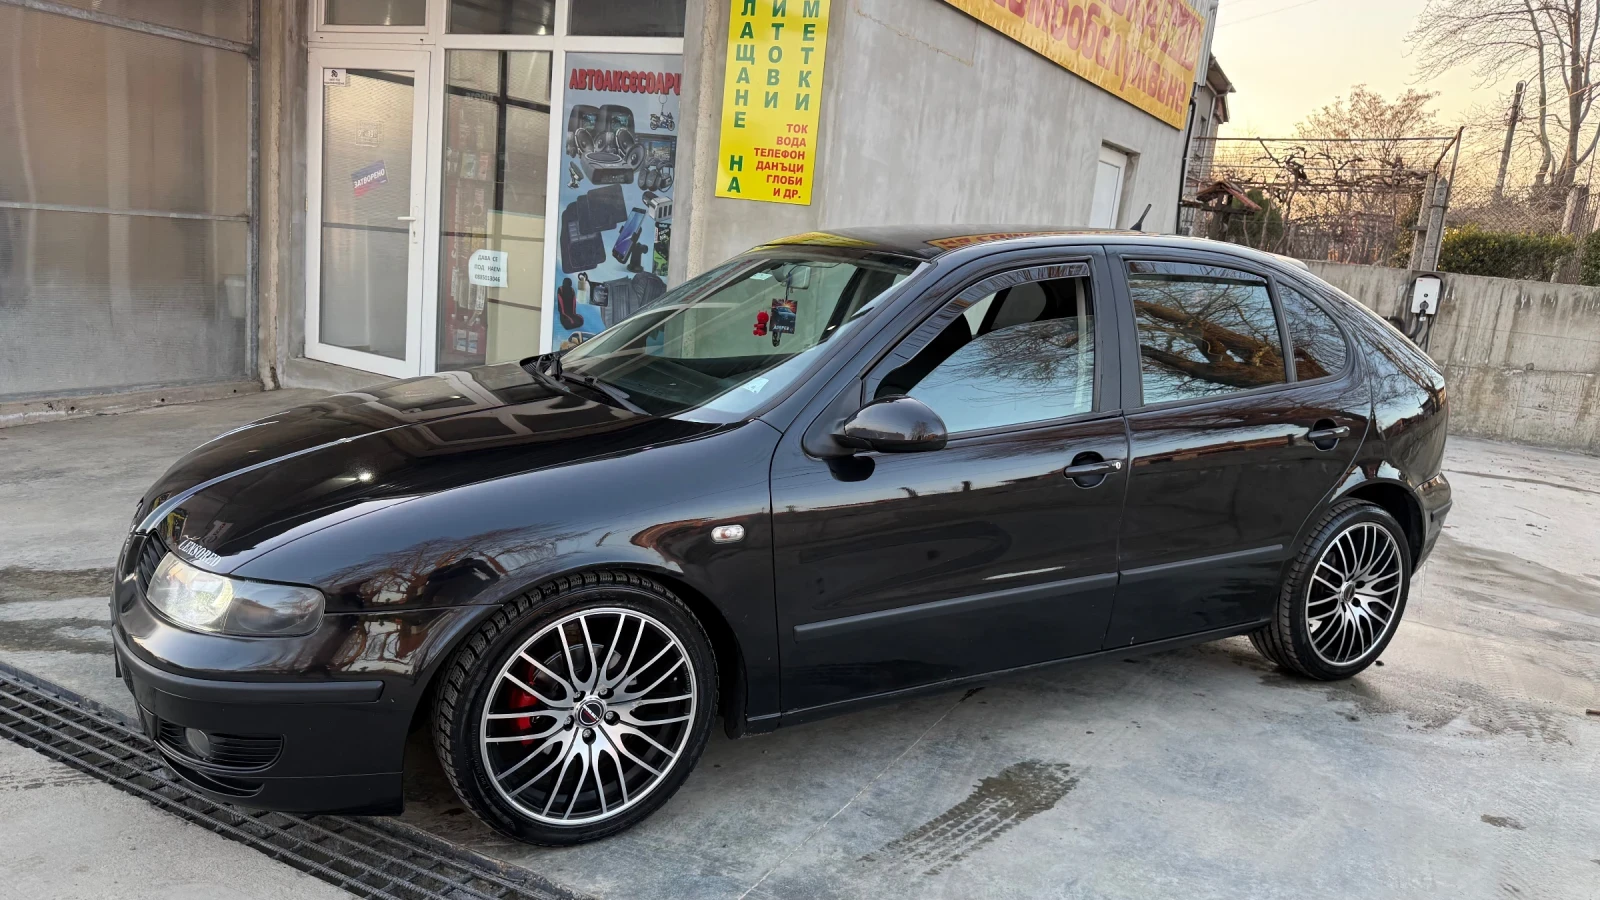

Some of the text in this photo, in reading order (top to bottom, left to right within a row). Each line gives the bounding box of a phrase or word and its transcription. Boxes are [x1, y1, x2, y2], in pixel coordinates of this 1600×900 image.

[794, 0, 820, 111] МЕТКИ
[786, 124, 808, 134] ТОК
[776, 136, 806, 148] ВОДА
[754, 147, 805, 160] ТЕЛЕФОН
[727, 154, 744, 194] НА
[756, 161, 804, 174] ДАНЪЦИ
[353, 169, 386, 189] ЗАТВОРЕНО
[766, 175, 803, 186] ГЛОБИ
[773, 188, 801, 200] И ДР.
[178, 539, 222, 568] CENSORED
